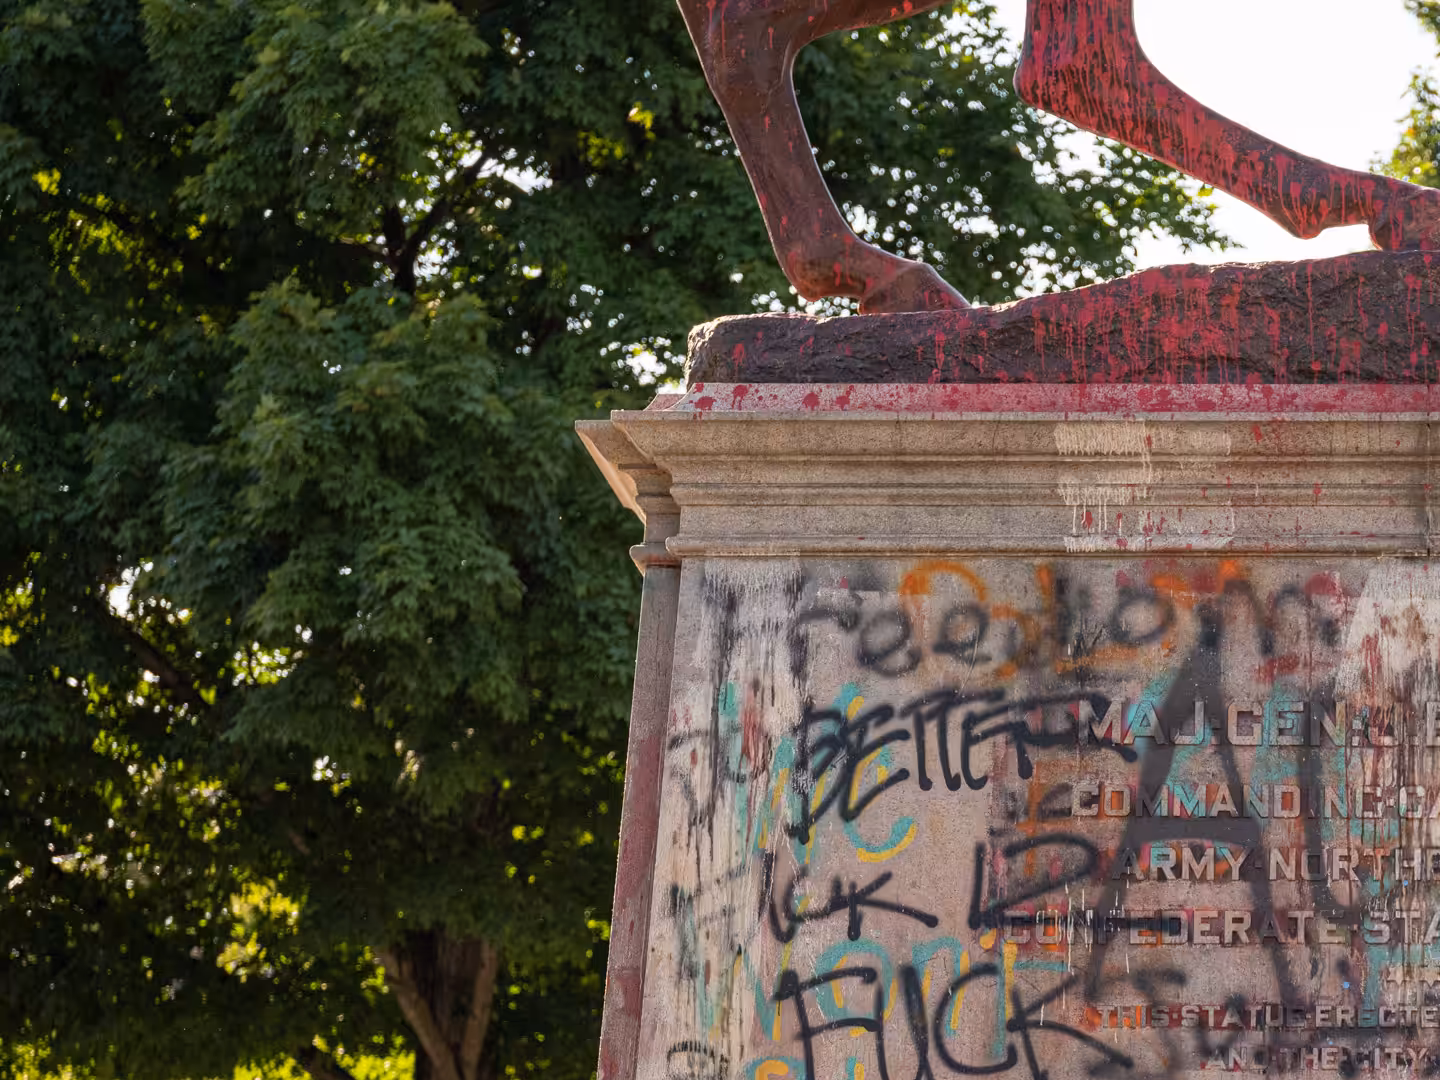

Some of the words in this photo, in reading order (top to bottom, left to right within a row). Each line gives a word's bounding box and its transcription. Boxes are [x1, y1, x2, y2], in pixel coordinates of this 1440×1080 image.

[1071, 784, 1384, 819] COMMANDING
[1112, 846, 1250, 881] ARMY
[1003, 908, 1347, 945] CONFEDERATE
[1096, 1004, 1170, 1028] THIS
[1181, 1004, 1306, 1029] STATUE
[1202, 1047, 1269, 1072] AND
[1279, 1047, 1339, 1072] THE
